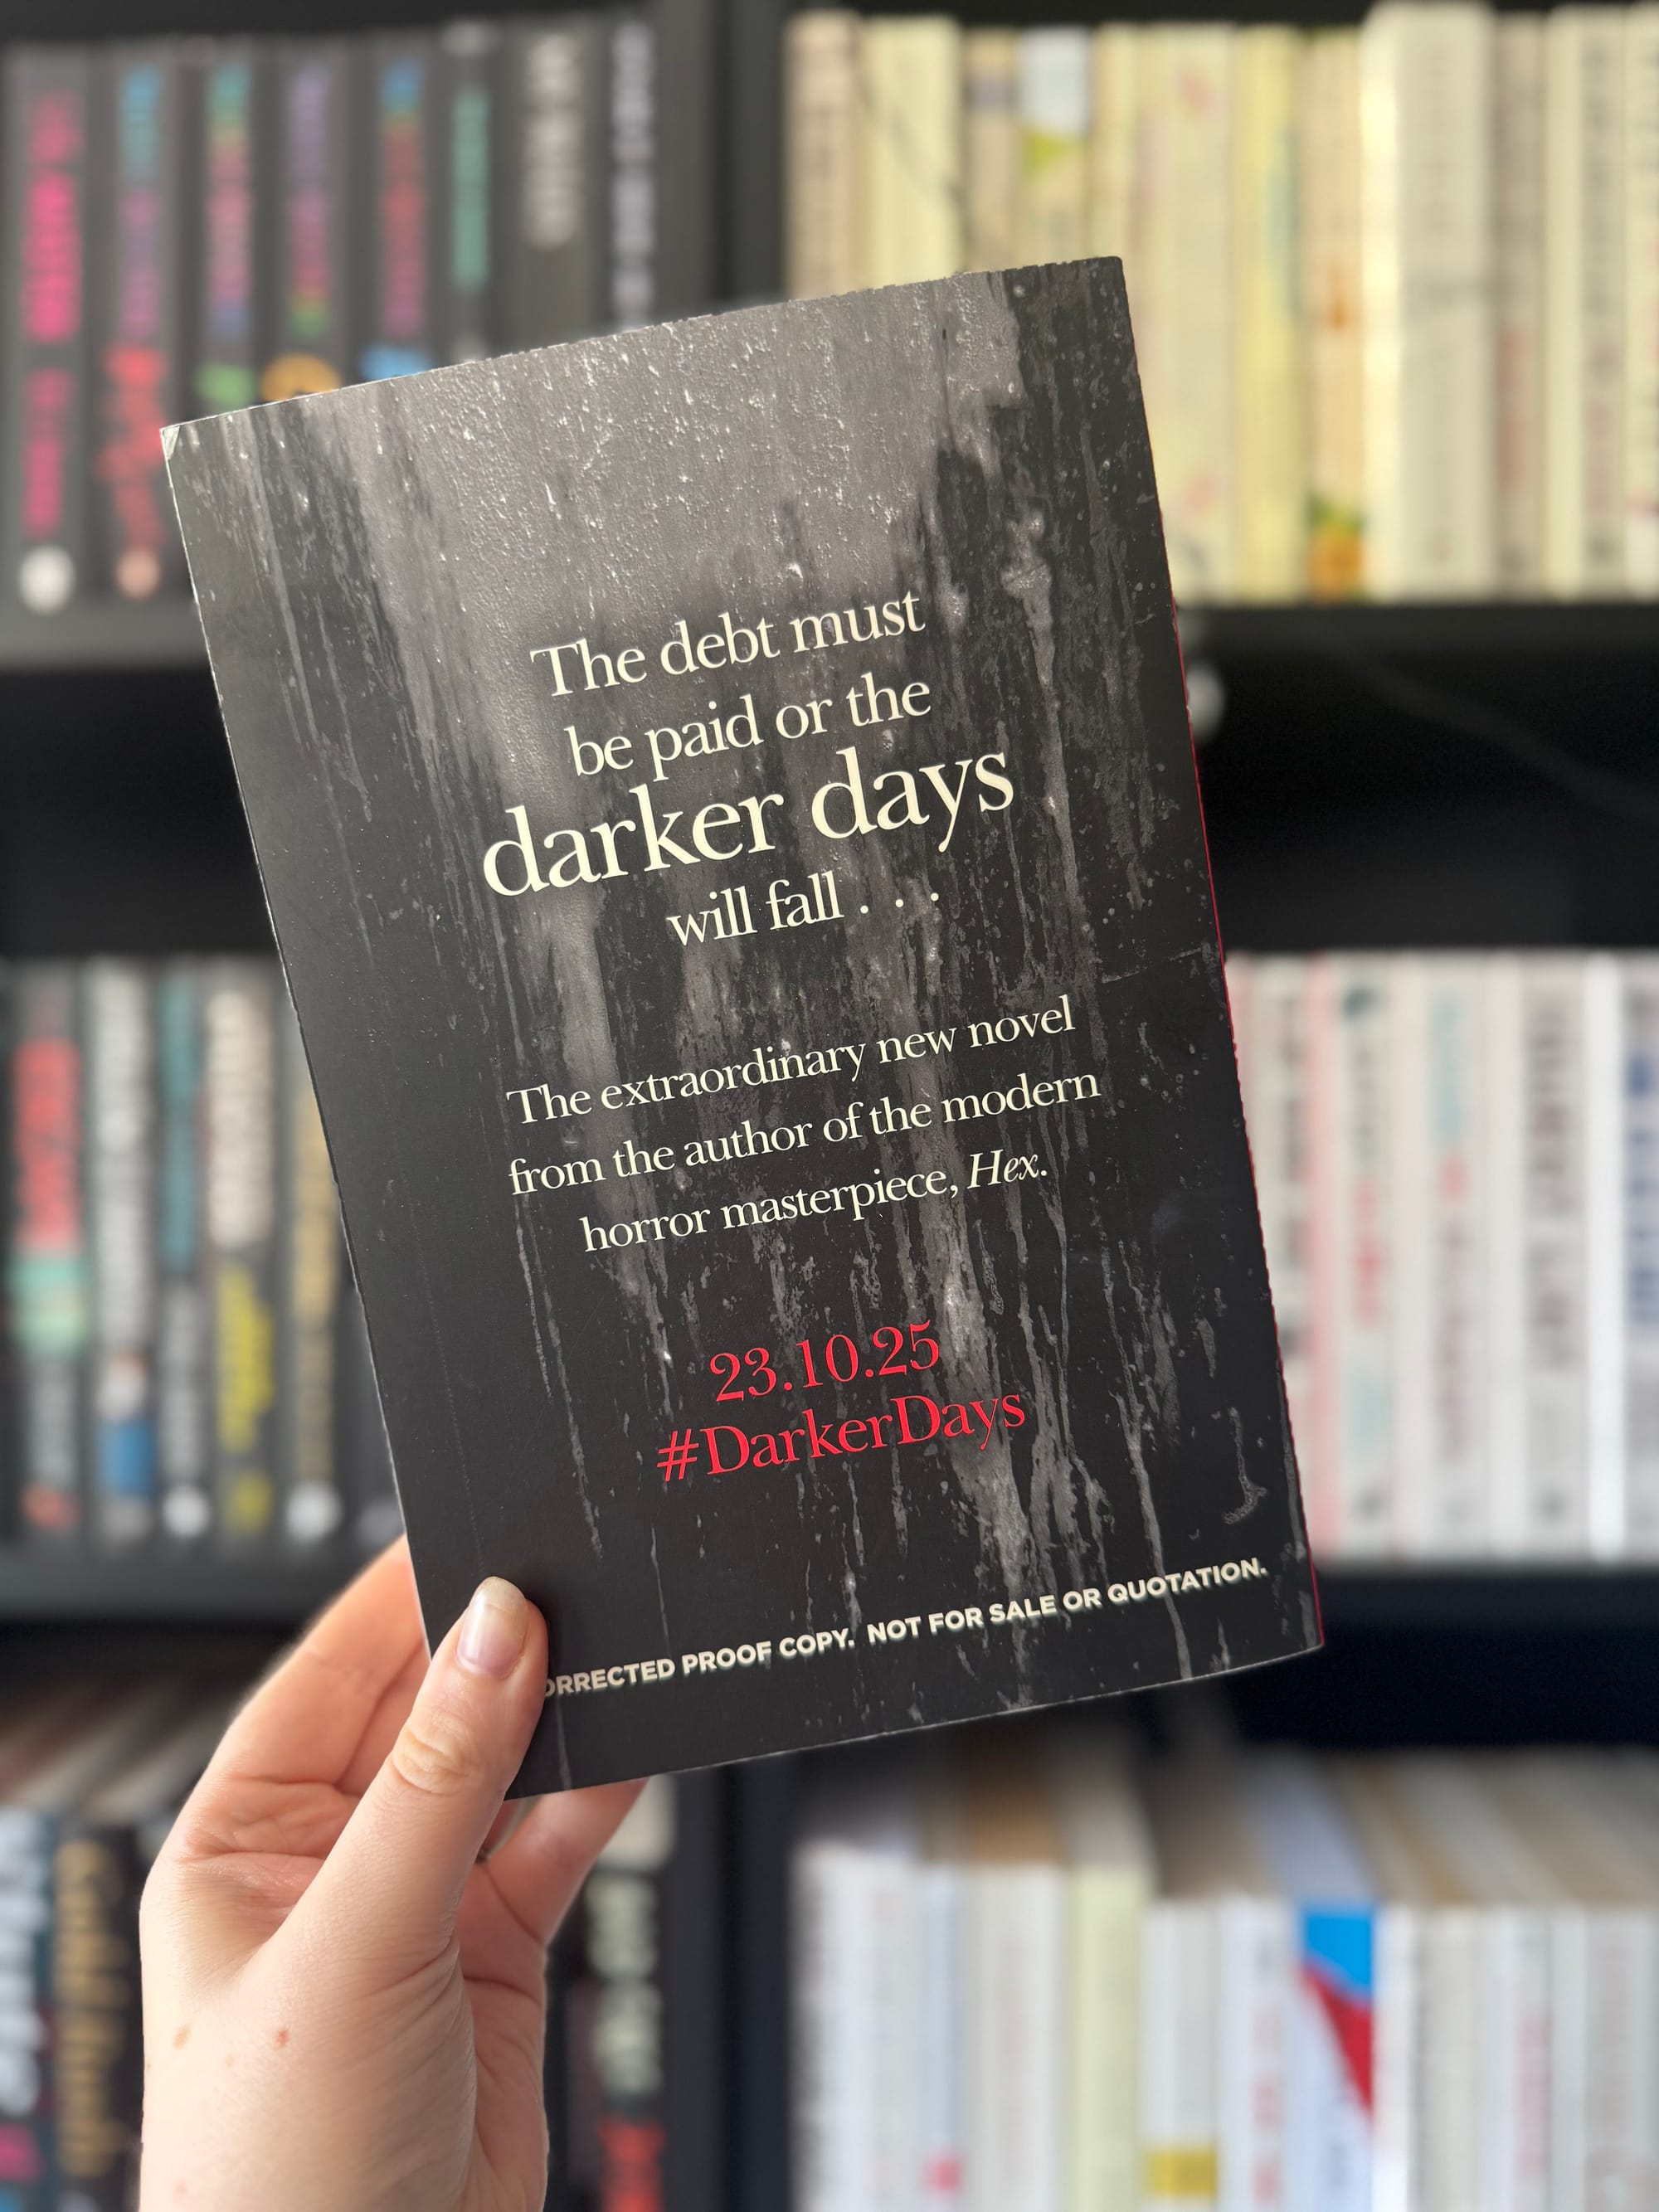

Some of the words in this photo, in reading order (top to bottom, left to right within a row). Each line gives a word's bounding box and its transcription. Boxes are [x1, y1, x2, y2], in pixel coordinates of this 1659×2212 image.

[529, 637, 648, 698] The
[660, 611, 781, 675] debt
[793, 591, 926, 653] must
[563, 725, 634, 776] be
[644, 693, 765, 782] paid
[776, 698, 833, 739] or
[845, 671, 932, 727] the
[483, 783, 784, 897] darker
[811, 746, 1014, 853] days
[665, 885, 758, 946] will
[765, 869, 845, 931] fall
[505, 1083, 592, 1124] The
[601, 1045, 866, 1110] extraordinary
[876, 1028, 957, 1064] new
[967, 994, 1076, 1048] novel
[508, 1158, 607, 1195] from
[612, 1140, 675, 1178] the
[684, 1120, 813, 1166] author
[823, 1101, 864, 1142] of
[868, 1096, 932, 1135] the
[941, 1072, 1102, 1123] modern
[579, 1209, 711, 1252] horror
[720, 1170, 958, 1229] masterpiece,
[966, 1149, 1048, 1189] Hex.
[709, 1320, 941, 1402] 23.10.25
[656, 1393, 1026, 1482] #DarkerDays
[681, 1641, 772, 1675] PROOF
[779, 1627, 855, 1658] COPY.
[867, 1616, 922, 1645] NOT
[928, 1607, 985, 1634] FOR
[989, 1594, 1058, 1624] SALE
[1063, 1587, 1102, 1612] OR
[1107, 1557, 1267, 1603] QUOTATION.
